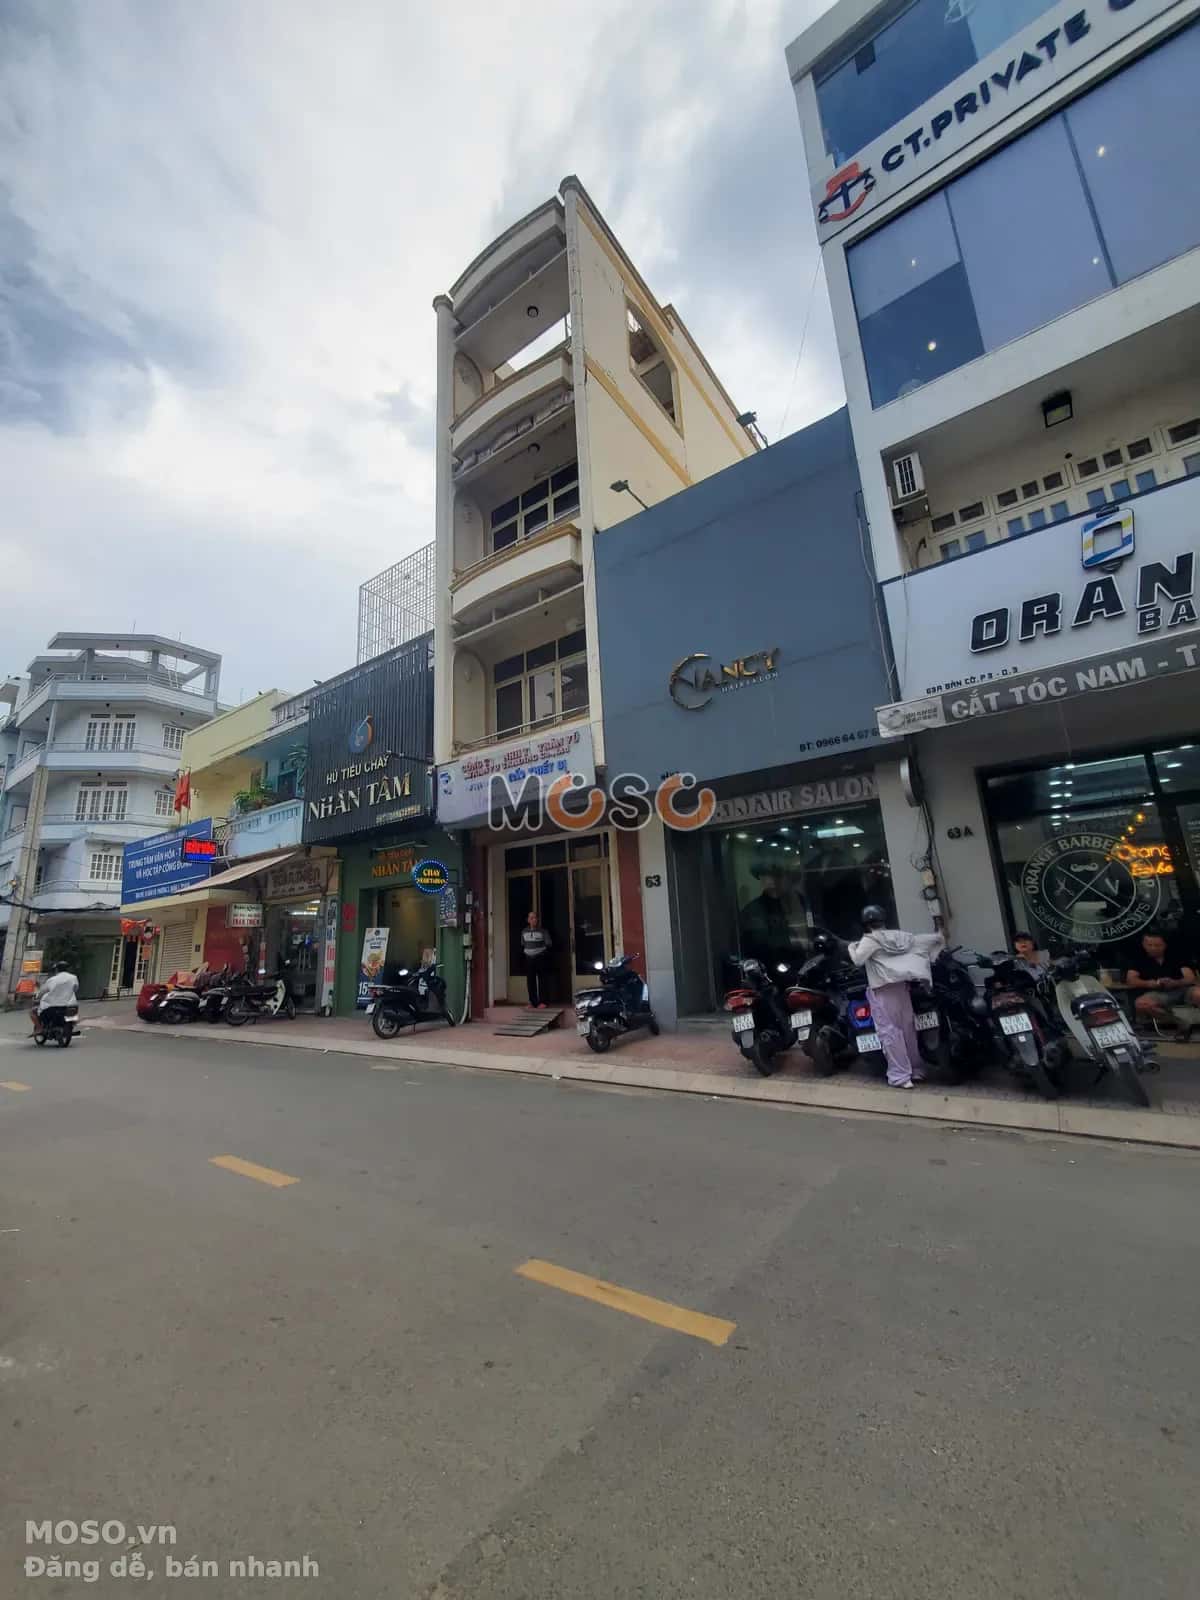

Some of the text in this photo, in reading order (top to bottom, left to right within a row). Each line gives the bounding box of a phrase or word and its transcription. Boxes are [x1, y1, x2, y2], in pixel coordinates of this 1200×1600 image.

[881, 8, 1091, 173] CT.PRIVATE
[951, 688, 1001, 719] CẮT
[1009, 676, 1068, 705] TÓC
[1076, 657, 1147, 693] NAM
[363, 754, 390, 774] CHAY
[366, 772, 412, 806] TÂM
[422, 868, 441, 877] CHAY
[645, 874, 661, 888] 63
[1025, 846, 1059, 895] ORANGE
